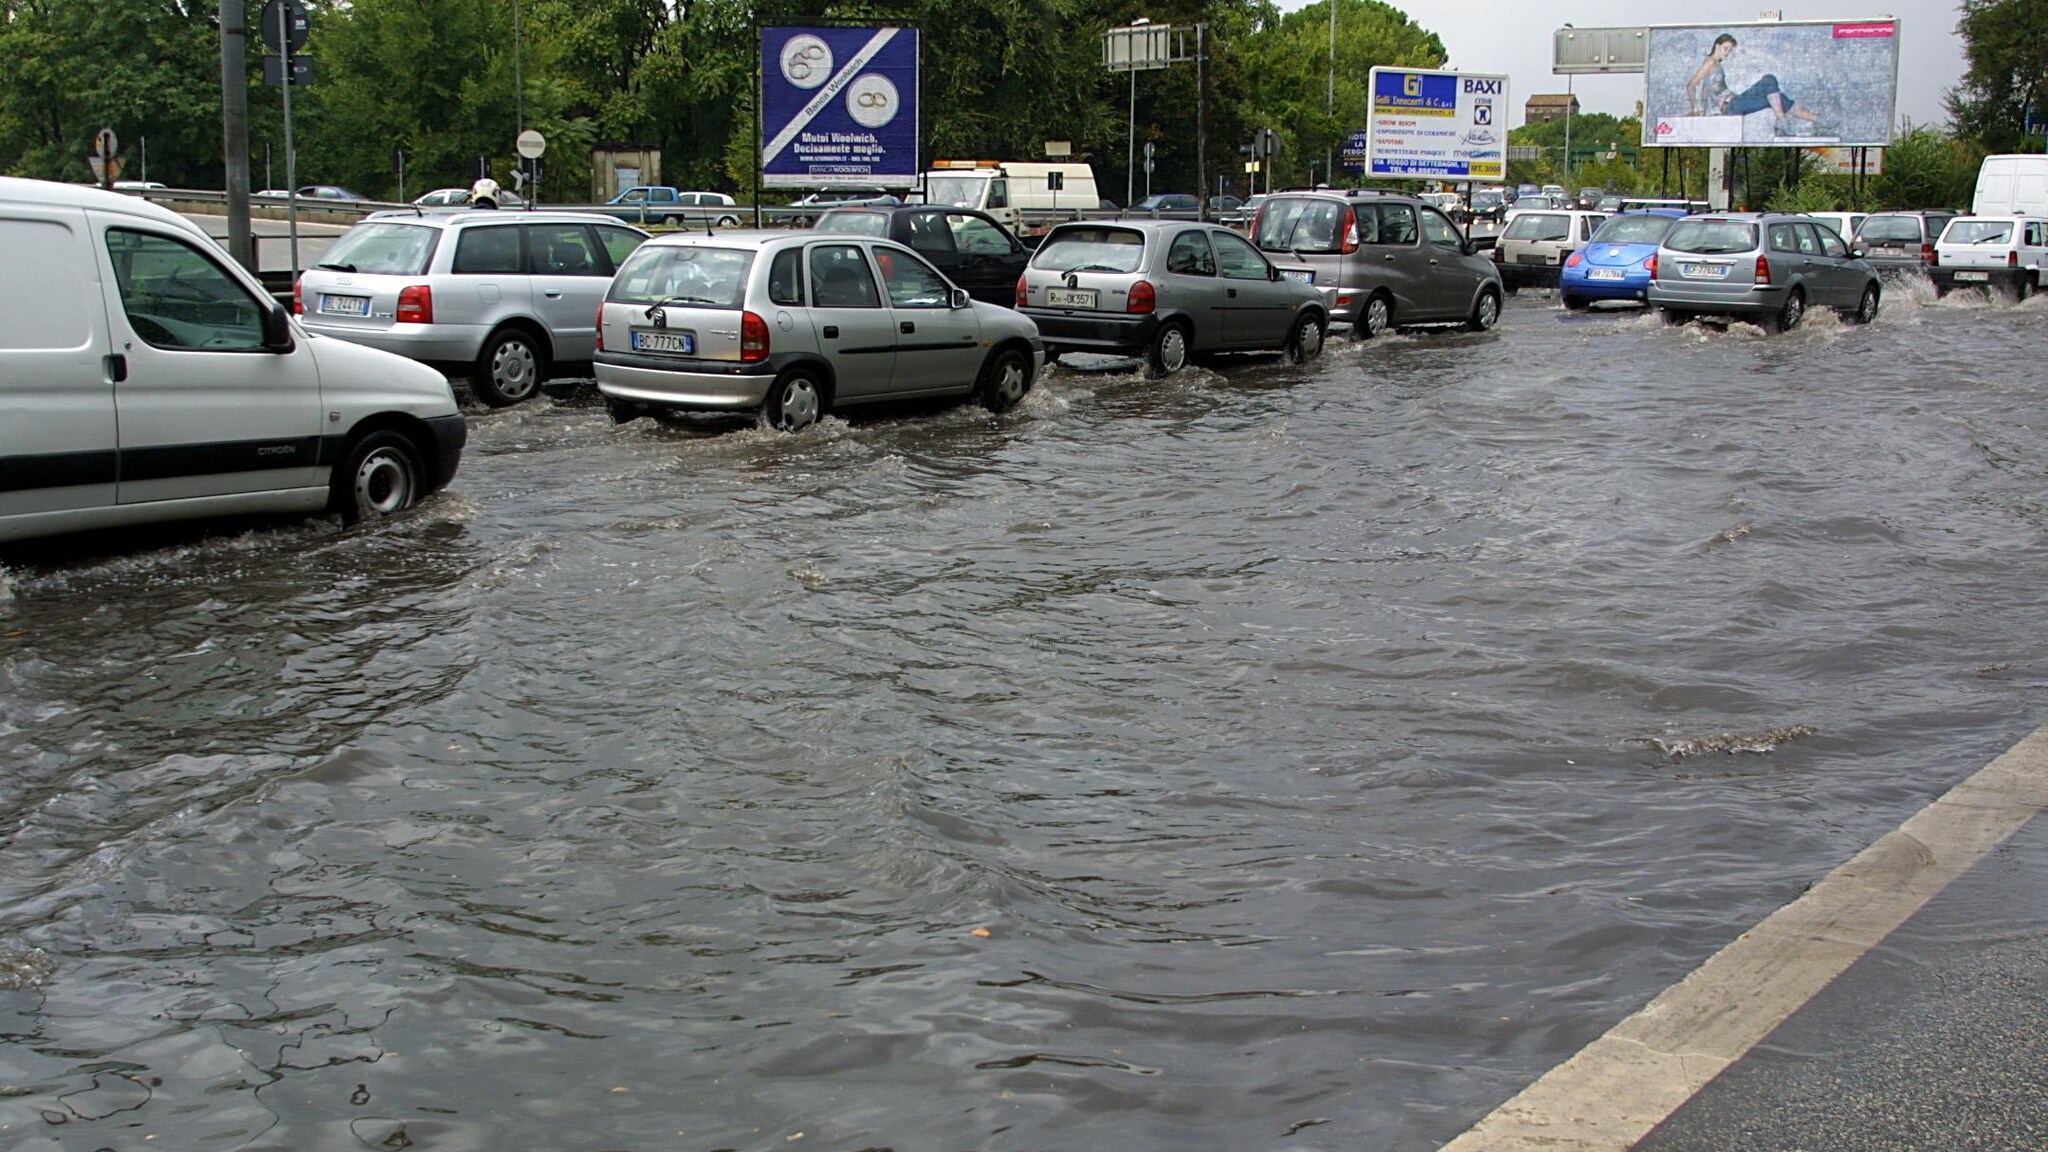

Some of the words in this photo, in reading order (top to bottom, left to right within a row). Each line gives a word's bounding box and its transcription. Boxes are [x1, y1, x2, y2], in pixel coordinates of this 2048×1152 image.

[828, 57, 864, 93] Woolwich
[1464, 80, 1502, 94] BAXI
[802, 133, 828, 143] Mutui
[832, 132, 878, 143] Woolwich.
[794, 143, 850, 153] Decisamente
[853, 143, 886, 155] meglio.
